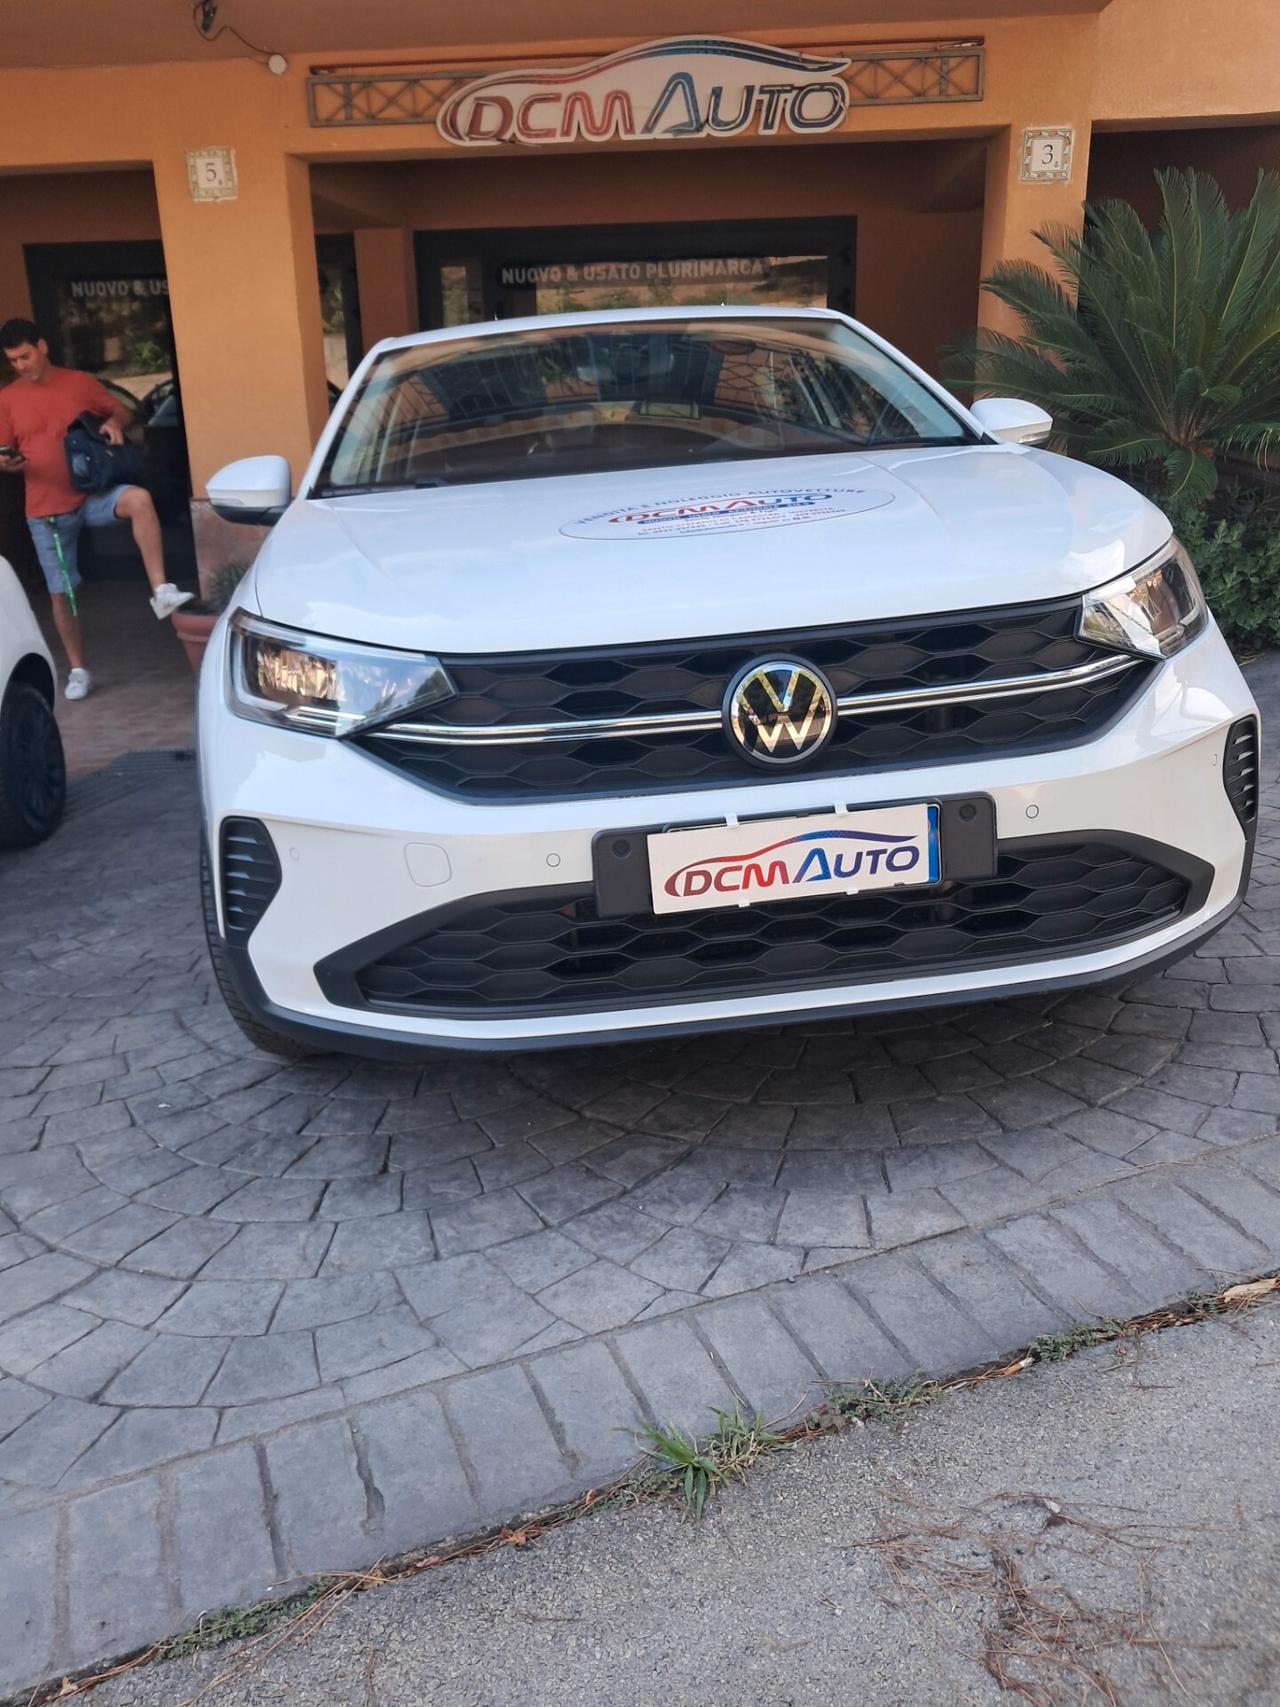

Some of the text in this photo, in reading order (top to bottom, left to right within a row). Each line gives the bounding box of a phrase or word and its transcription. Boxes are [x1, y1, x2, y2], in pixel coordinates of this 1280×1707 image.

[1040, 143, 1054, 165] 3
[205, 162, 217, 182] 5
[501, 258, 764, 285] NUOVO & USATO PLURIMARCA
[70, 280, 129, 298] NUOVO
[133, 280, 147, 297] &
